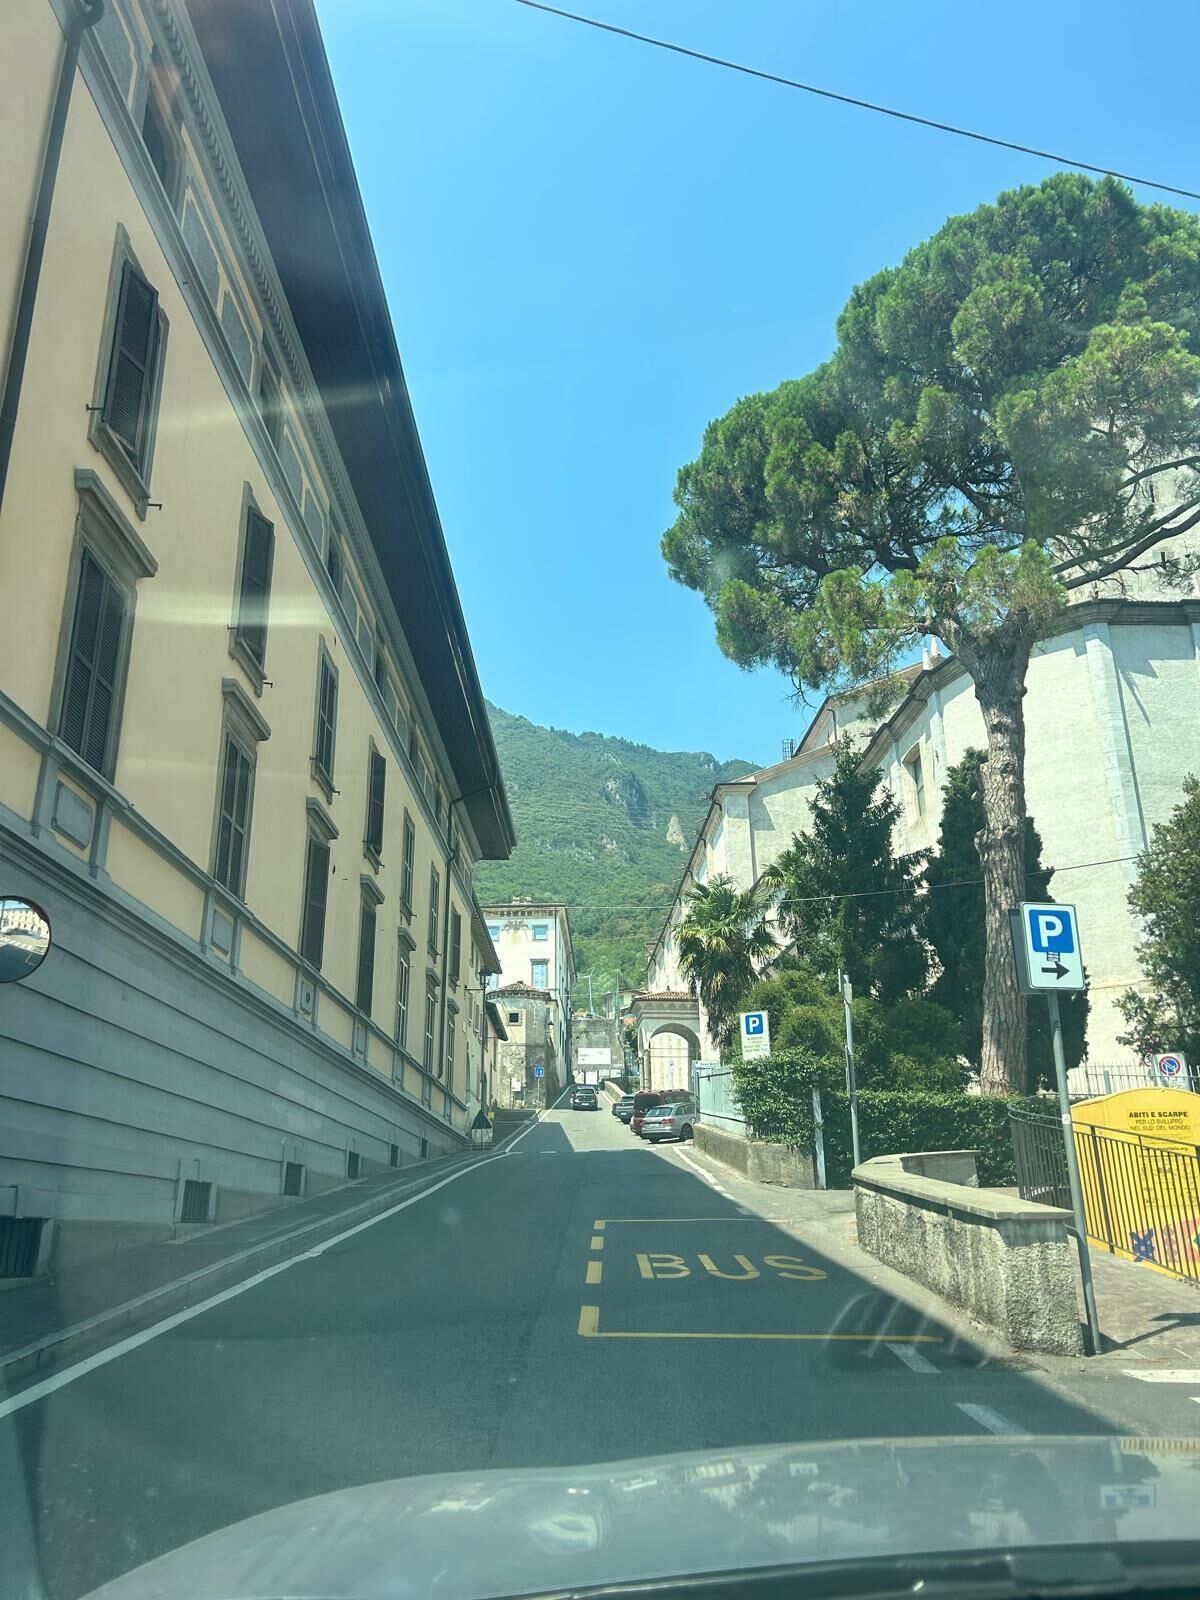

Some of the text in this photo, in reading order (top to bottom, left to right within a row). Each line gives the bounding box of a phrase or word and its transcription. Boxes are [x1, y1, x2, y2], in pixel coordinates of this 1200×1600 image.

[1038, 915, 1063, 948] P
[749, 1017, 760, 1033] P
[635, 1253, 828, 1281] BUS
